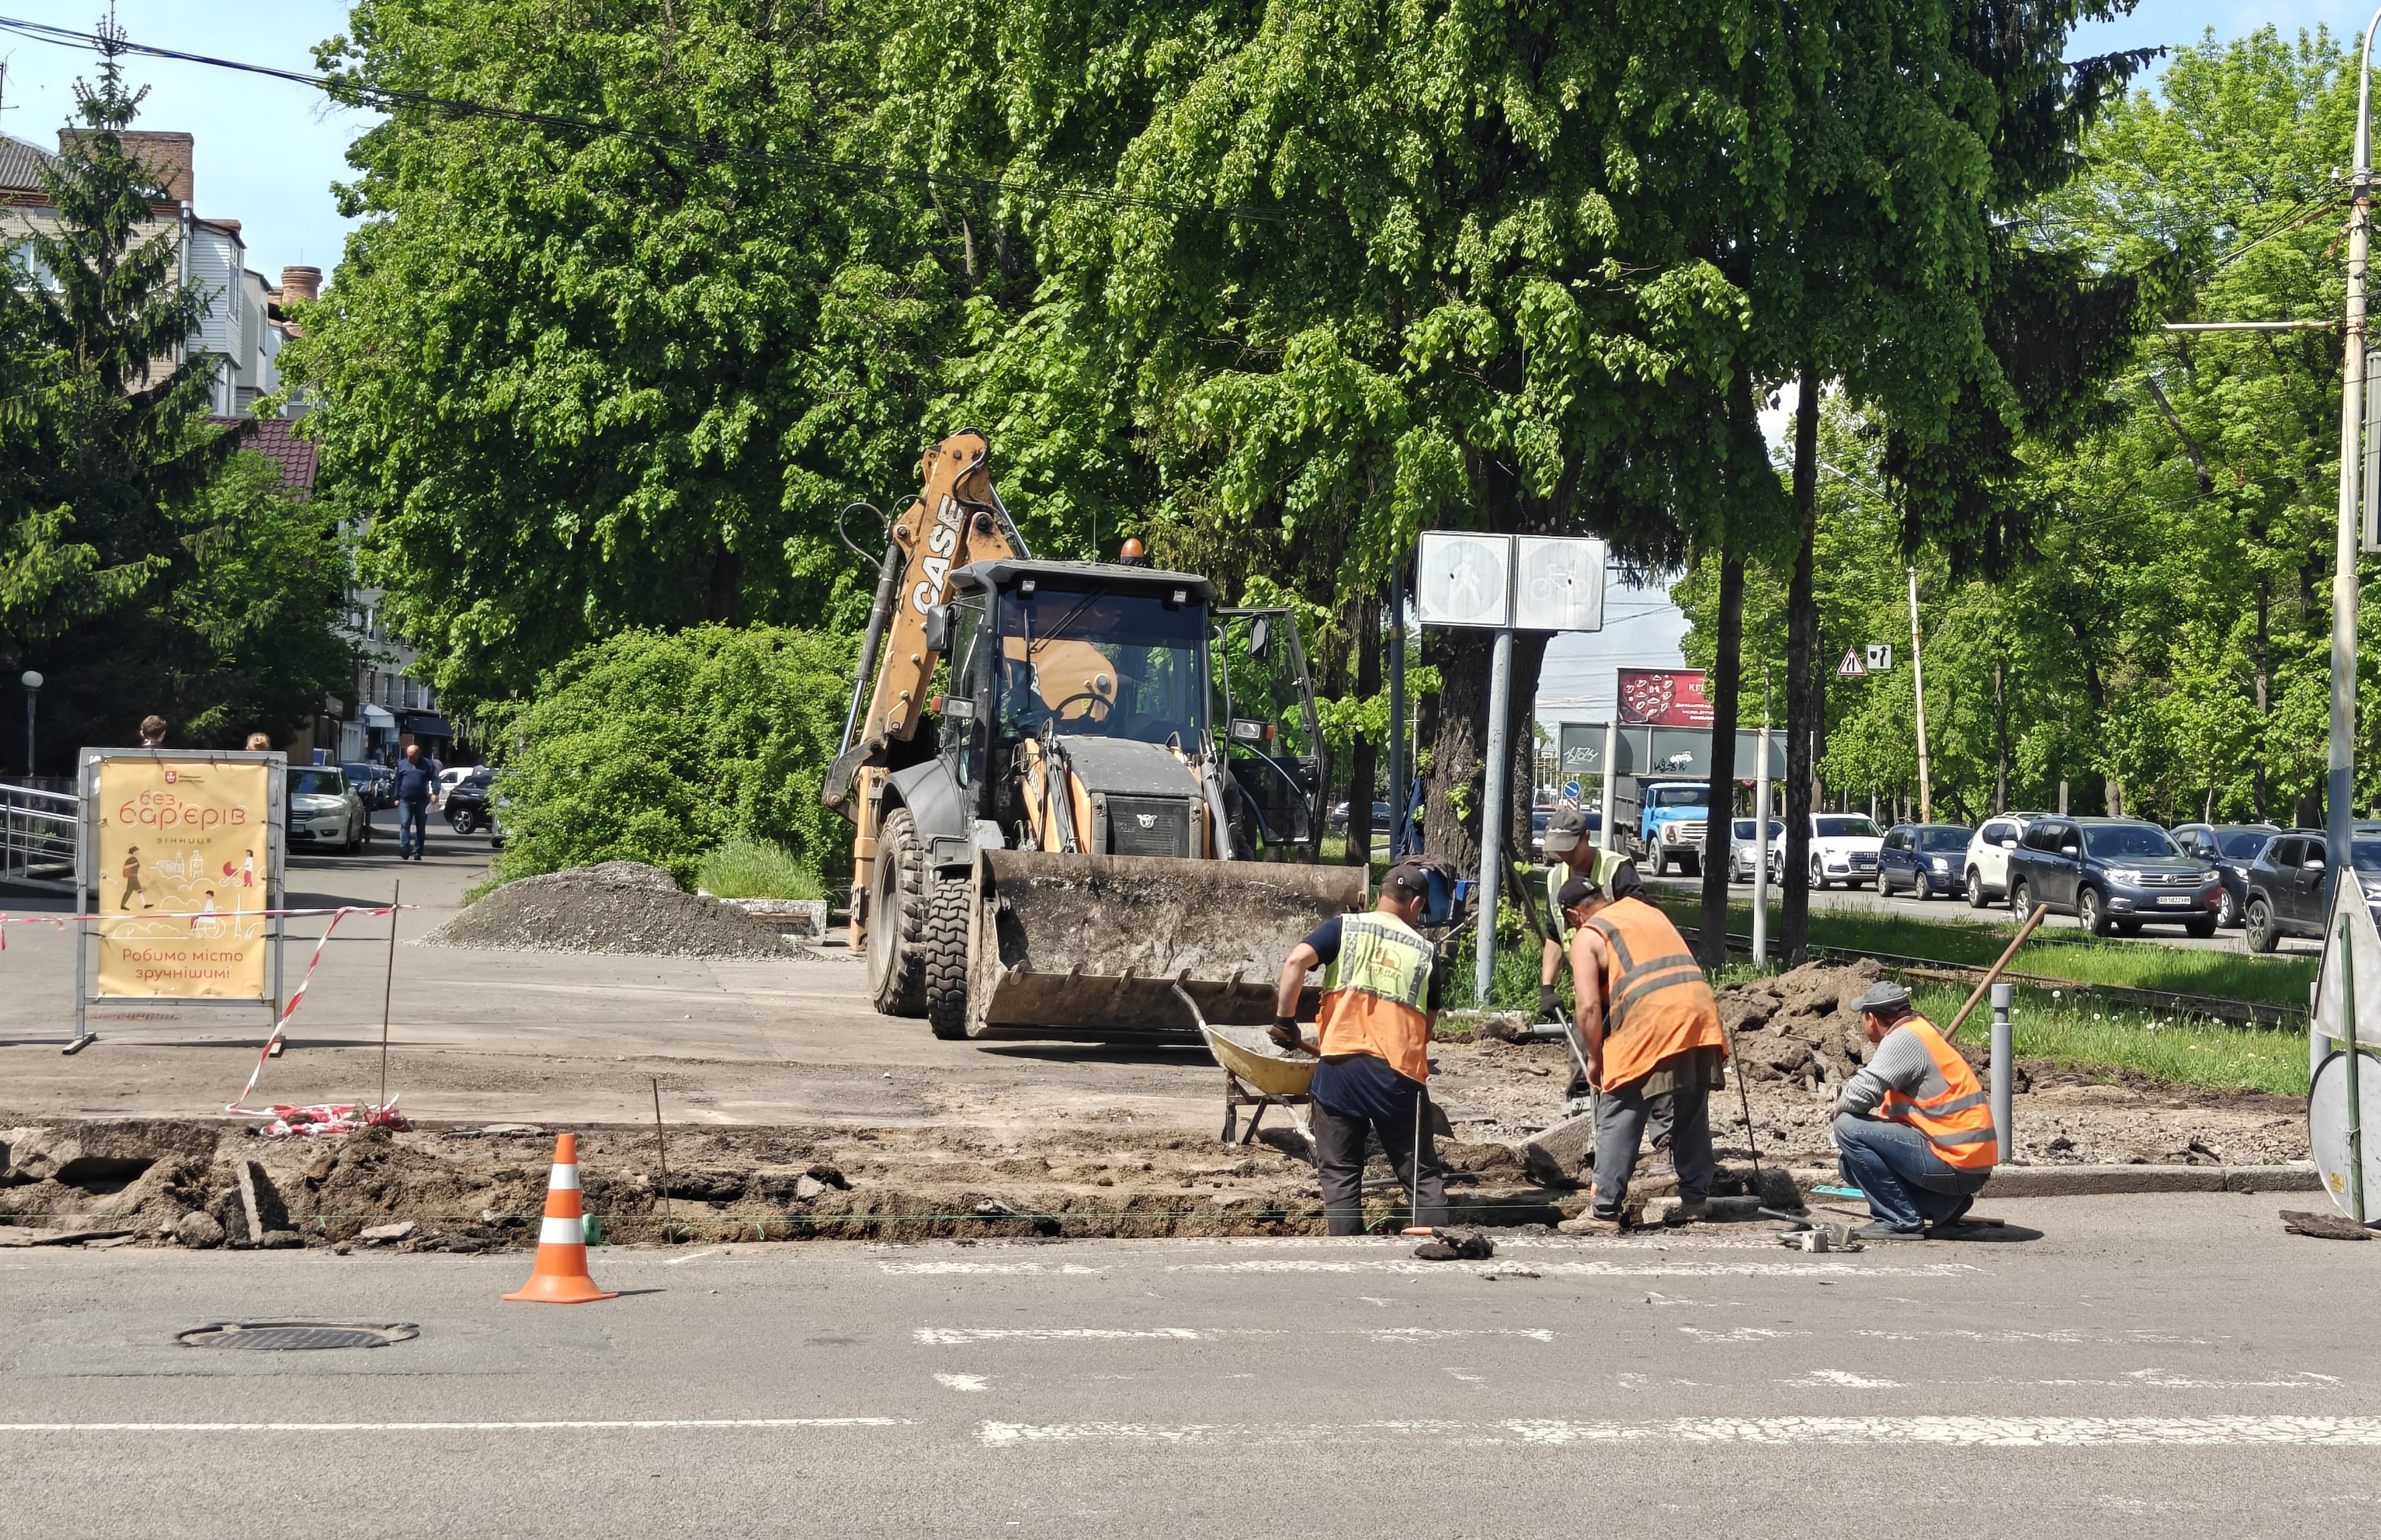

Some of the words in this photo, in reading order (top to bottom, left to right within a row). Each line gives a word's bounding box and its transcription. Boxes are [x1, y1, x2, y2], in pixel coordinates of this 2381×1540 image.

[912, 493, 964, 616] CASE
[140, 789, 175, 805] без
[122, 948, 186, 962] Робимо
[193, 948, 244, 962] місто
[136, 966, 230, 982] зручнішим!
